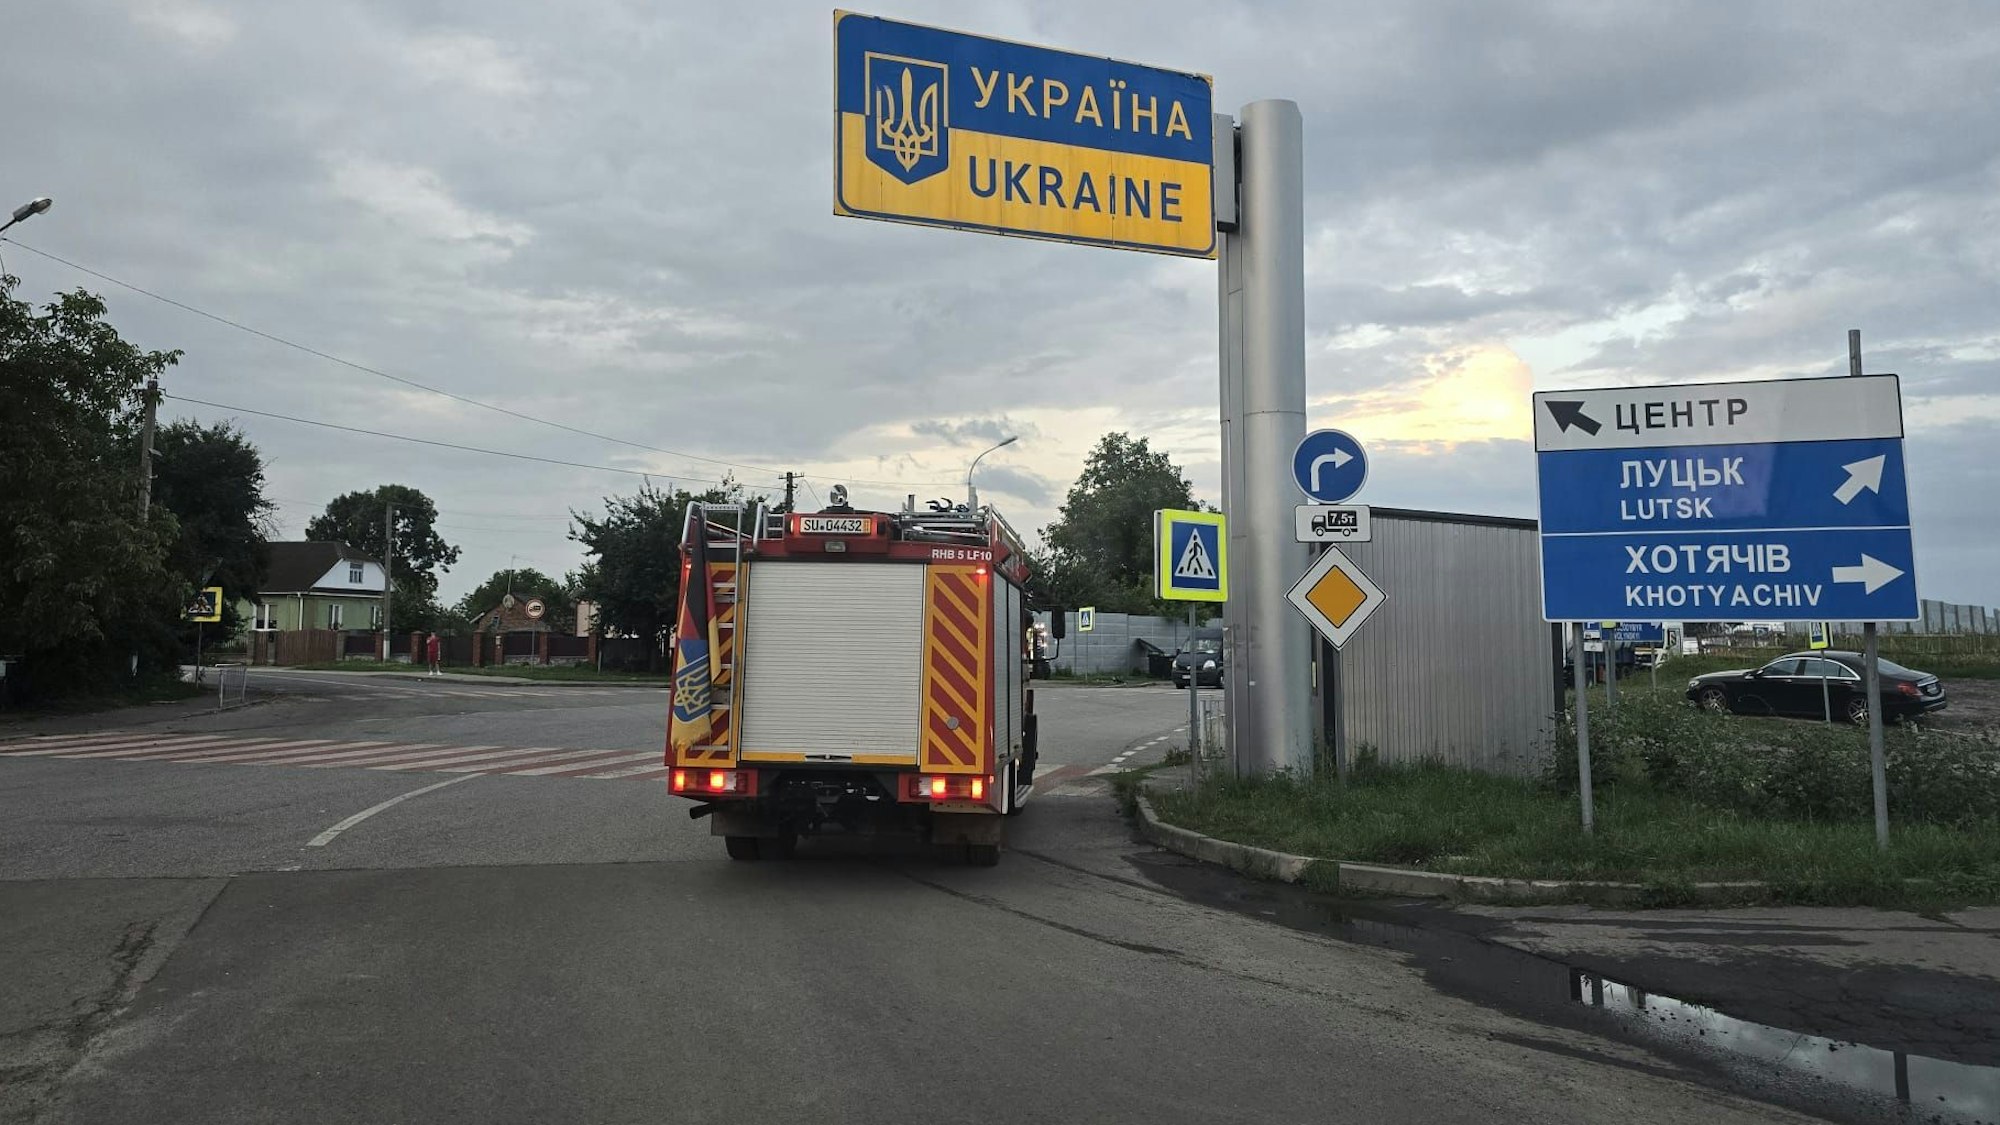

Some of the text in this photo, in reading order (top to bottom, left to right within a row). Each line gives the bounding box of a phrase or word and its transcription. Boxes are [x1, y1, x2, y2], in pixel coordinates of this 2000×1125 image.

[971, 67, 1192, 140] УКРАЇНА
[970, 156, 1182, 222] UKRAINE
[1617, 398, 1748, 434] ЦЕНТР
[1621, 457, 1744, 491] ЛУЦЬК
[1621, 498, 1714, 520] LUTSK
[932, 549, 992, 561] RHB 5 LF10
[1625, 544, 1791, 574] ХОТЯЧІВ
[1625, 584, 1822, 608] KHOTYACHIV
